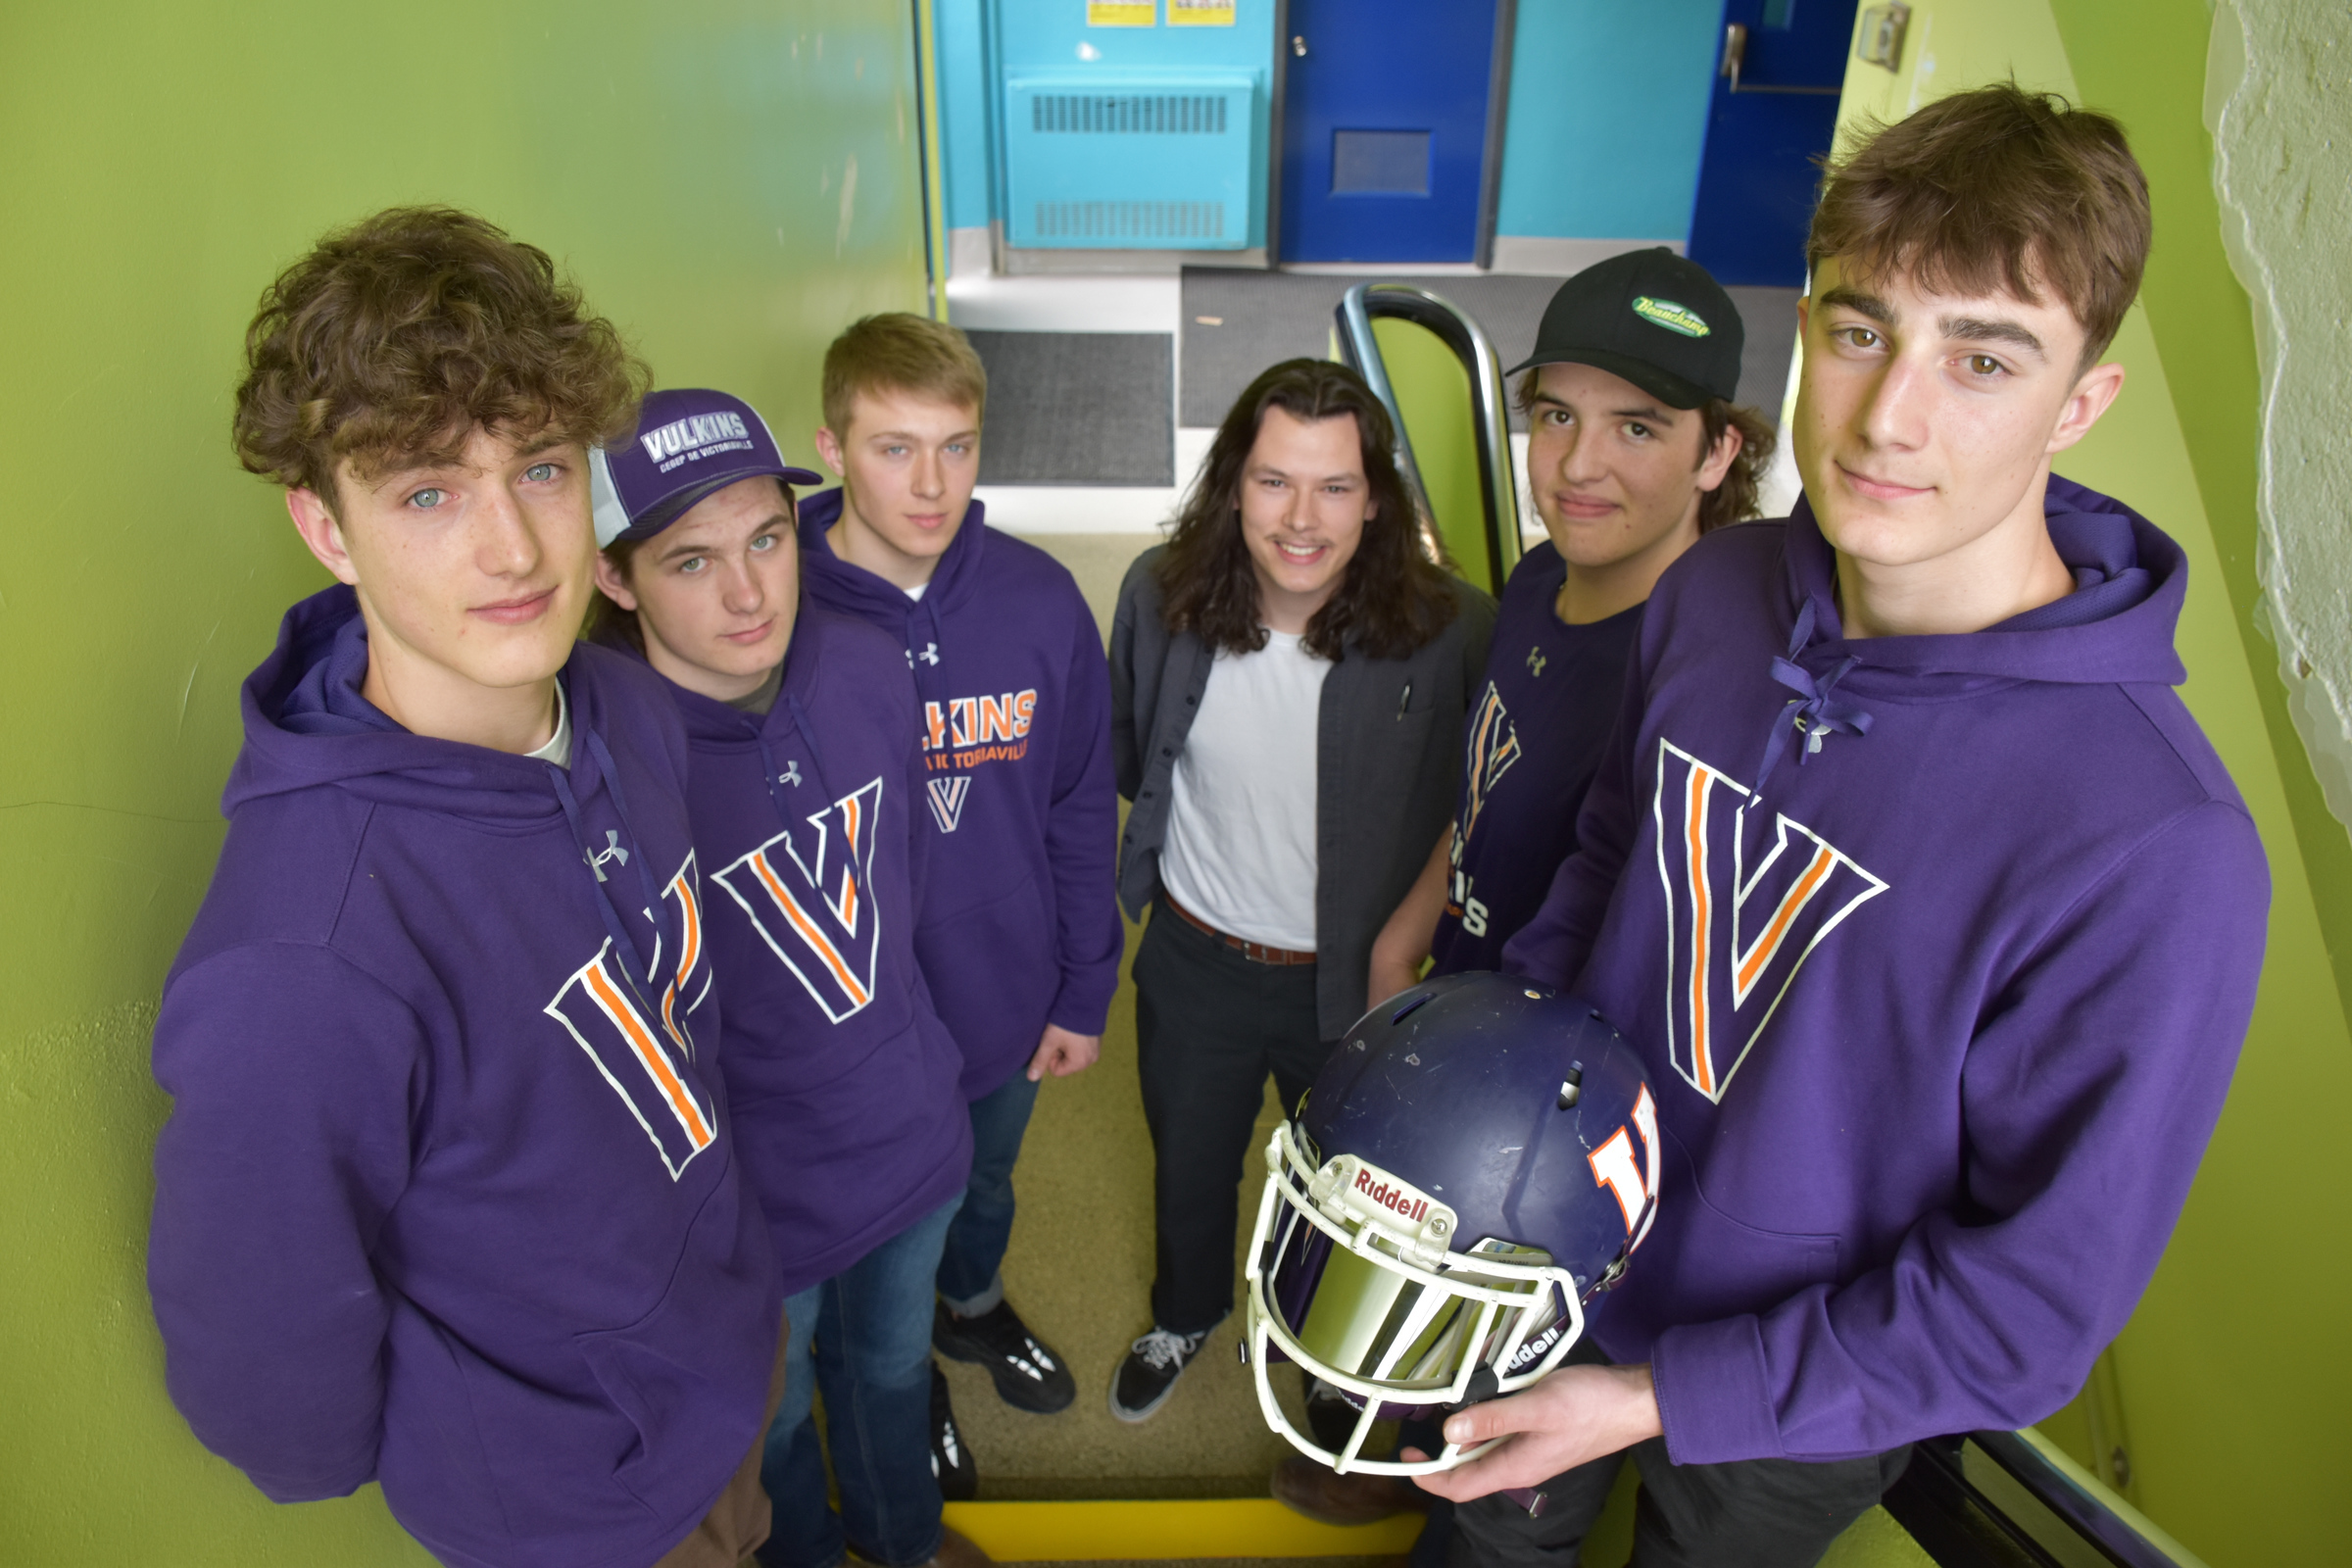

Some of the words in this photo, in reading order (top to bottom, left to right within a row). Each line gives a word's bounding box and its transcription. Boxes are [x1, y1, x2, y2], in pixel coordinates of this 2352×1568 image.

[640, 412, 750, 464] VULKINS
[922, 688, 1037, 752] KINS
[1354, 1167, 1429, 1223] Riddell
[1506, 1327, 1560, 1373] ddell
